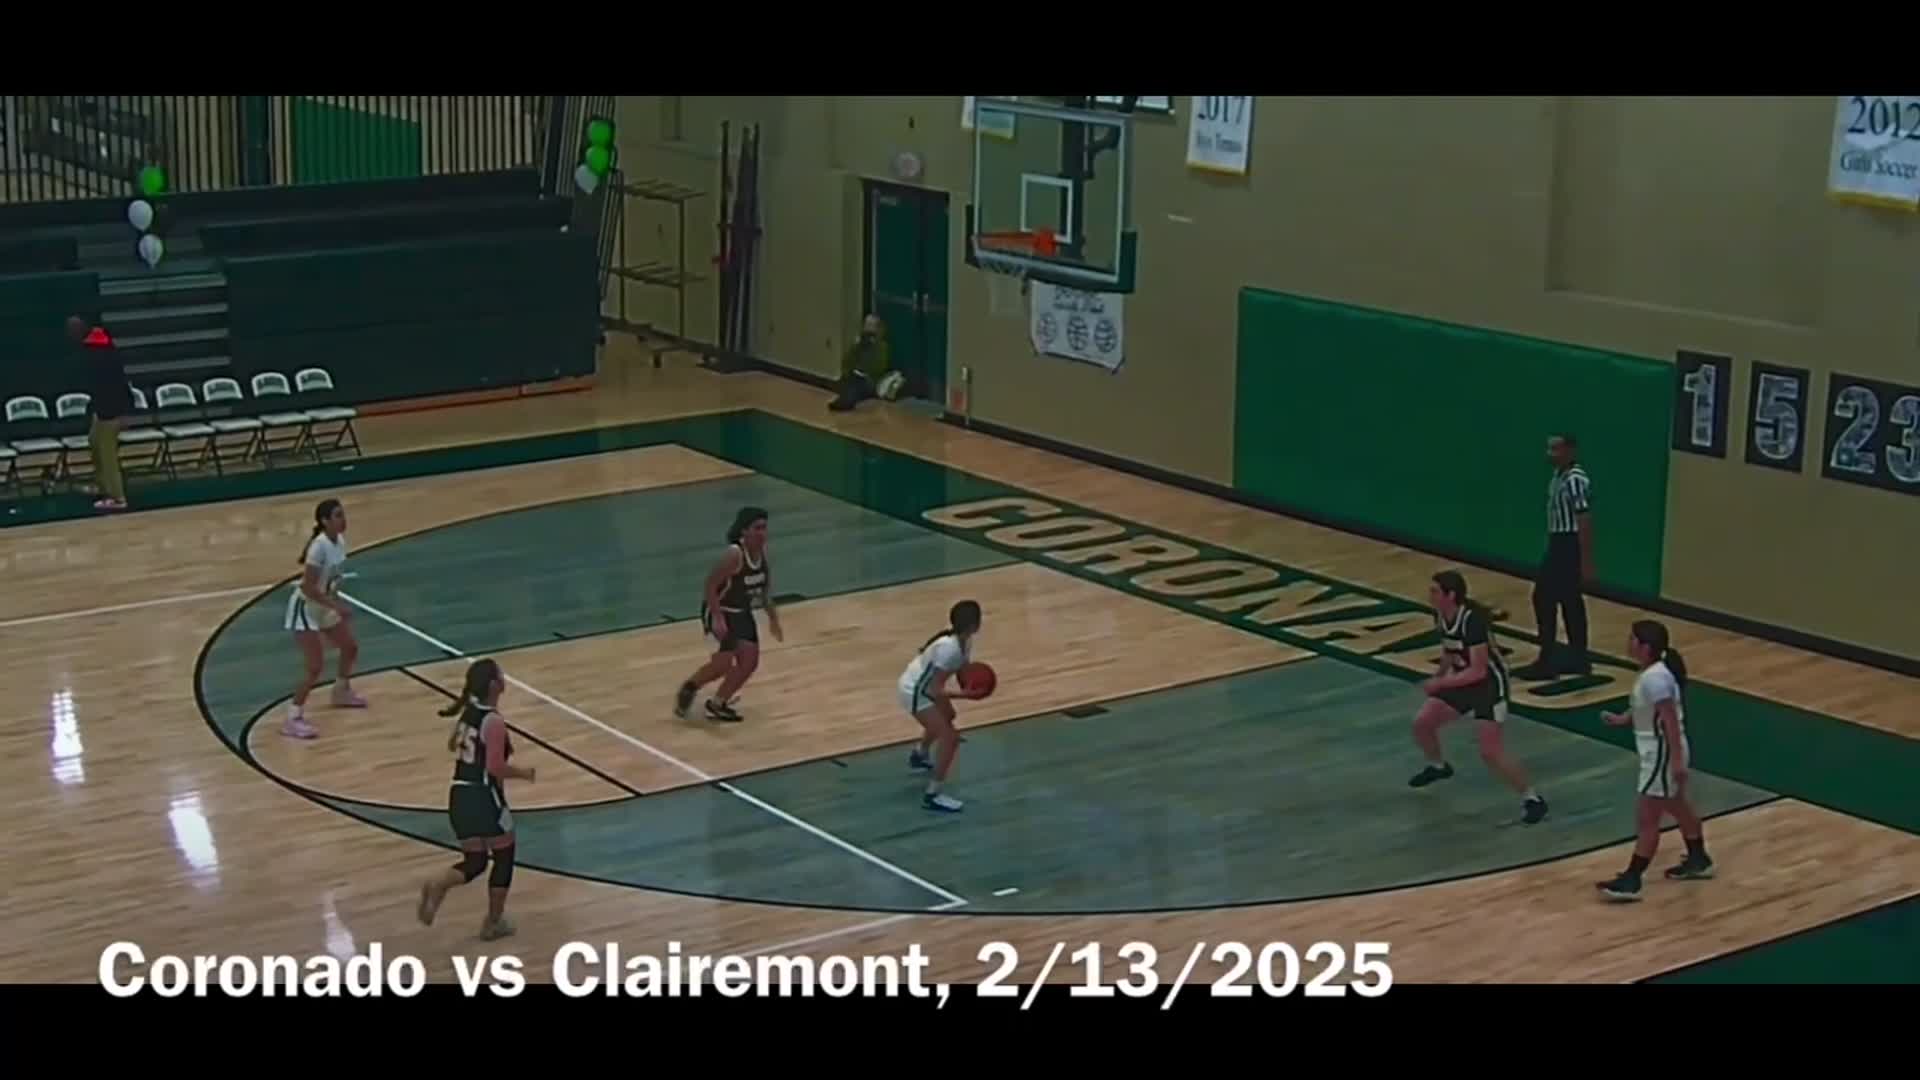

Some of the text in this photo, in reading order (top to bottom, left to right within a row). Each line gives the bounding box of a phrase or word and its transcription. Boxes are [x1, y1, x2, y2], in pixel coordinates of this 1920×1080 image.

[1847, 96, 1920, 140] 2012
[1683, 364, 1716, 447] 1
[1755, 373, 1799, 460] 5
